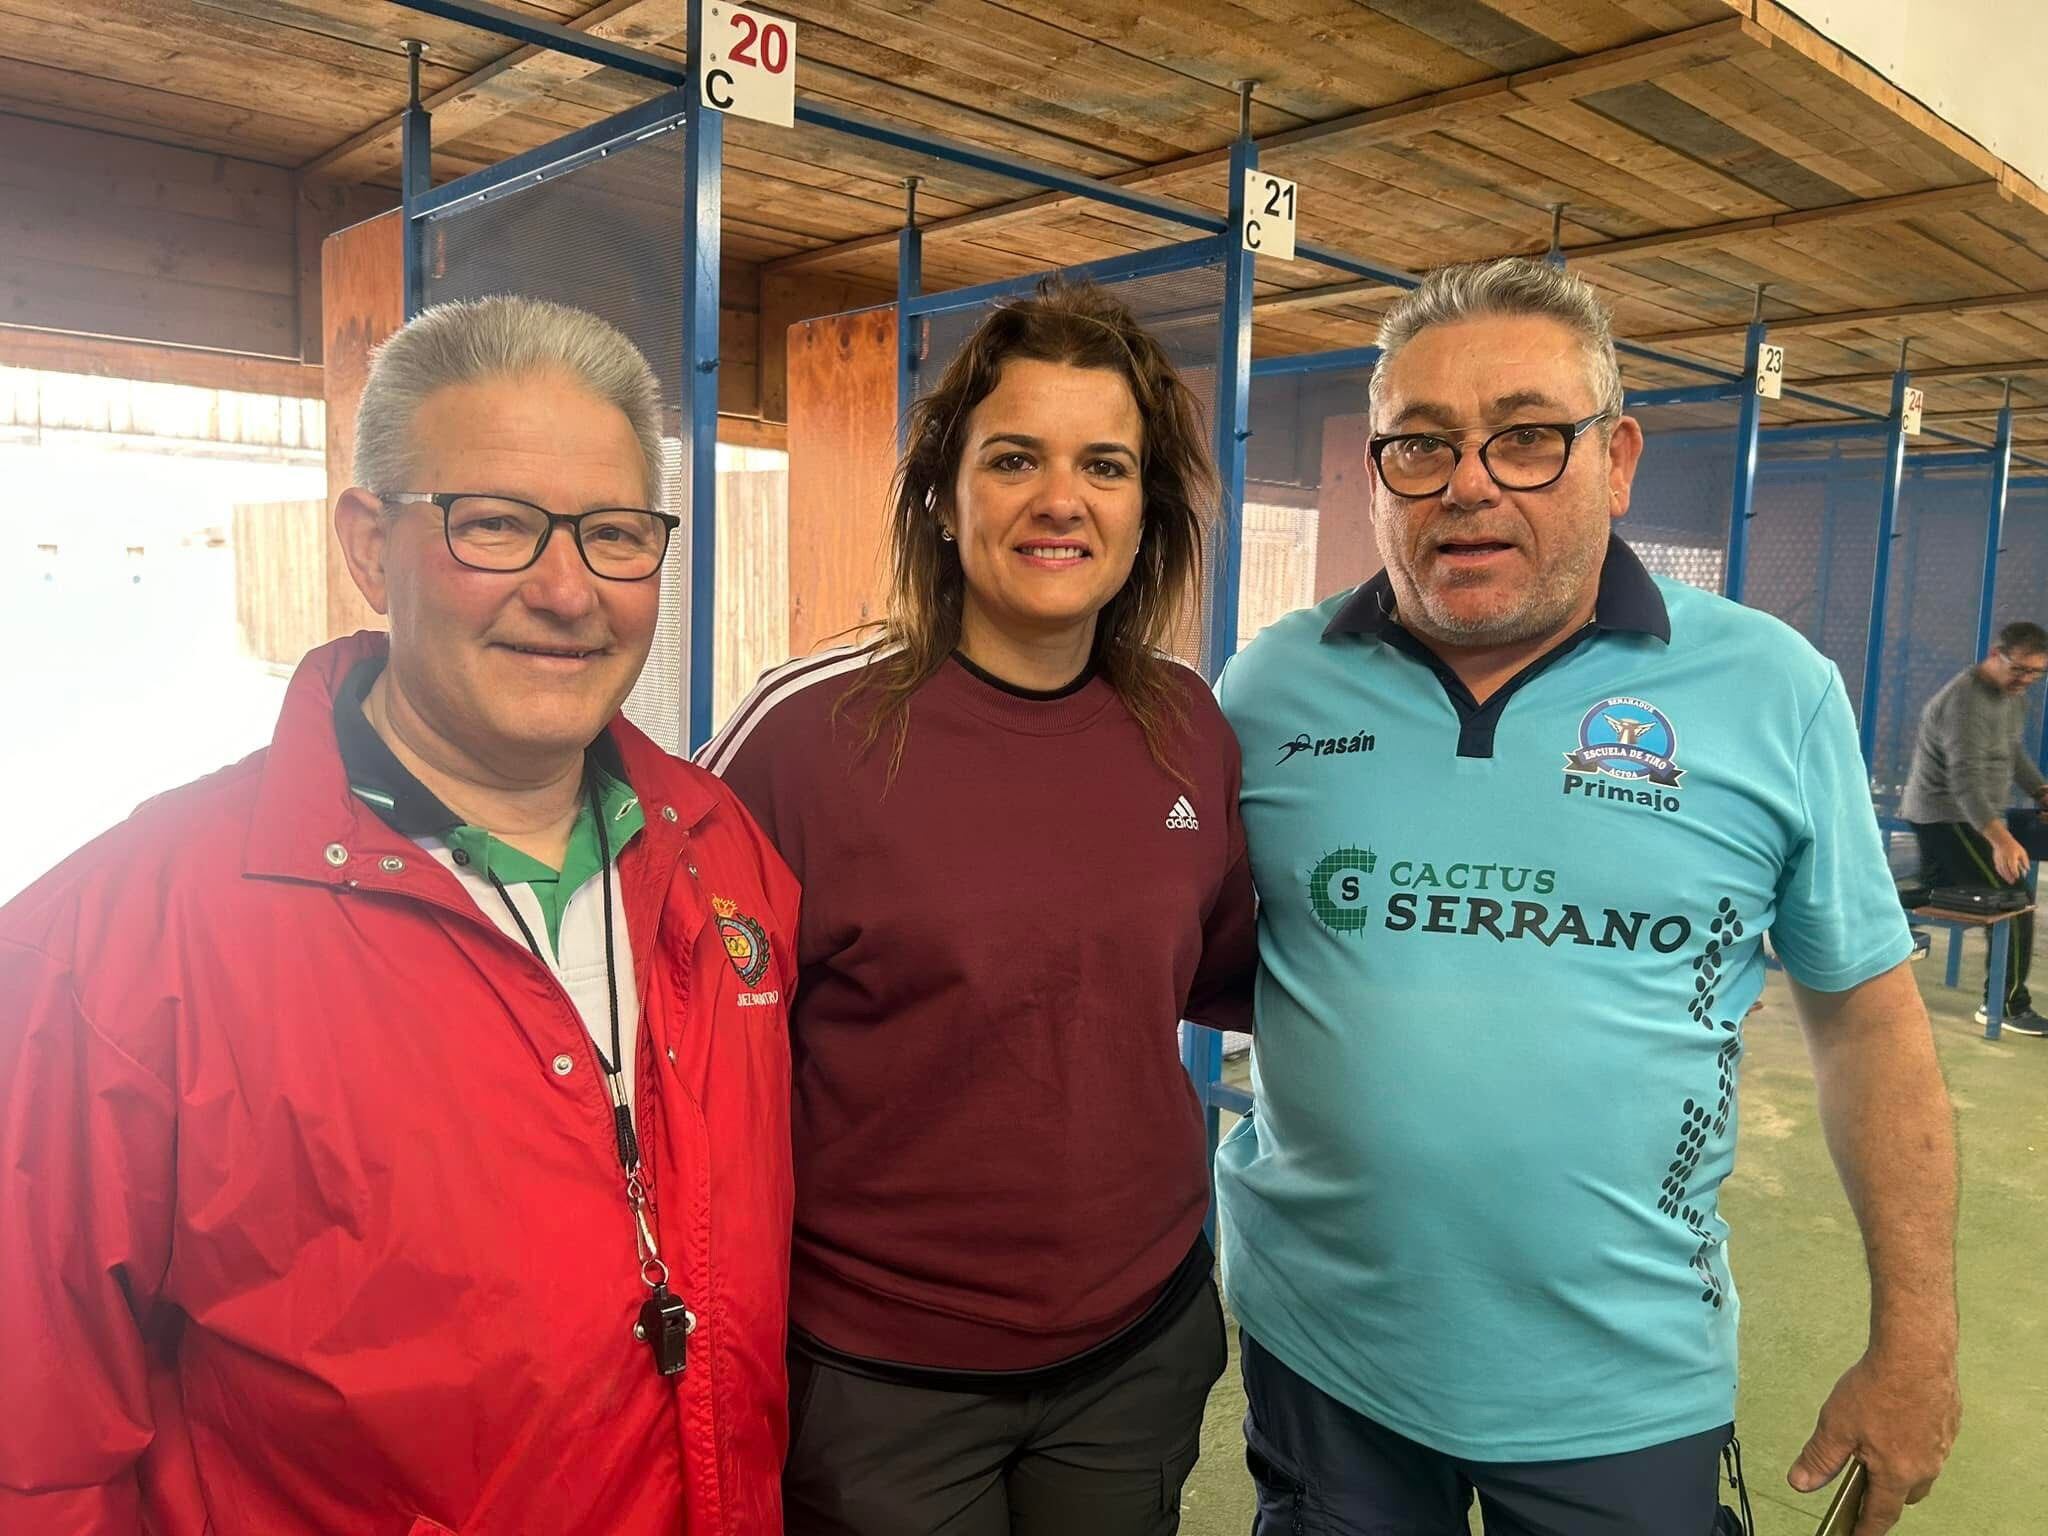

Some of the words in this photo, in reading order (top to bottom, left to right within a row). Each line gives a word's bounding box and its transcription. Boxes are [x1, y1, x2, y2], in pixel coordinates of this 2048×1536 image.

[728, 13, 788, 75] 20
[705, 68, 735, 109] C
[1263, 179, 1294, 220] 21
[1246, 220, 1261, 249] C
[1765, 347, 1781, 373] 23
[1757, 375, 1765, 394] C
[1908, 390, 1921, 413] 24
[1902, 414, 1909, 430] C
[1583, 746, 1627, 760] ESCUELA
[1629, 749, 1644, 760] DE
[1644, 753, 1667, 770] TIRO
[1563, 774, 1680, 812] Primajo
[1165, 815, 1199, 831] adida
[1341, 876, 1360, 901] S
[1389, 861, 1556, 895] CACTUS
[1384, 892, 1692, 954] SERRANO
